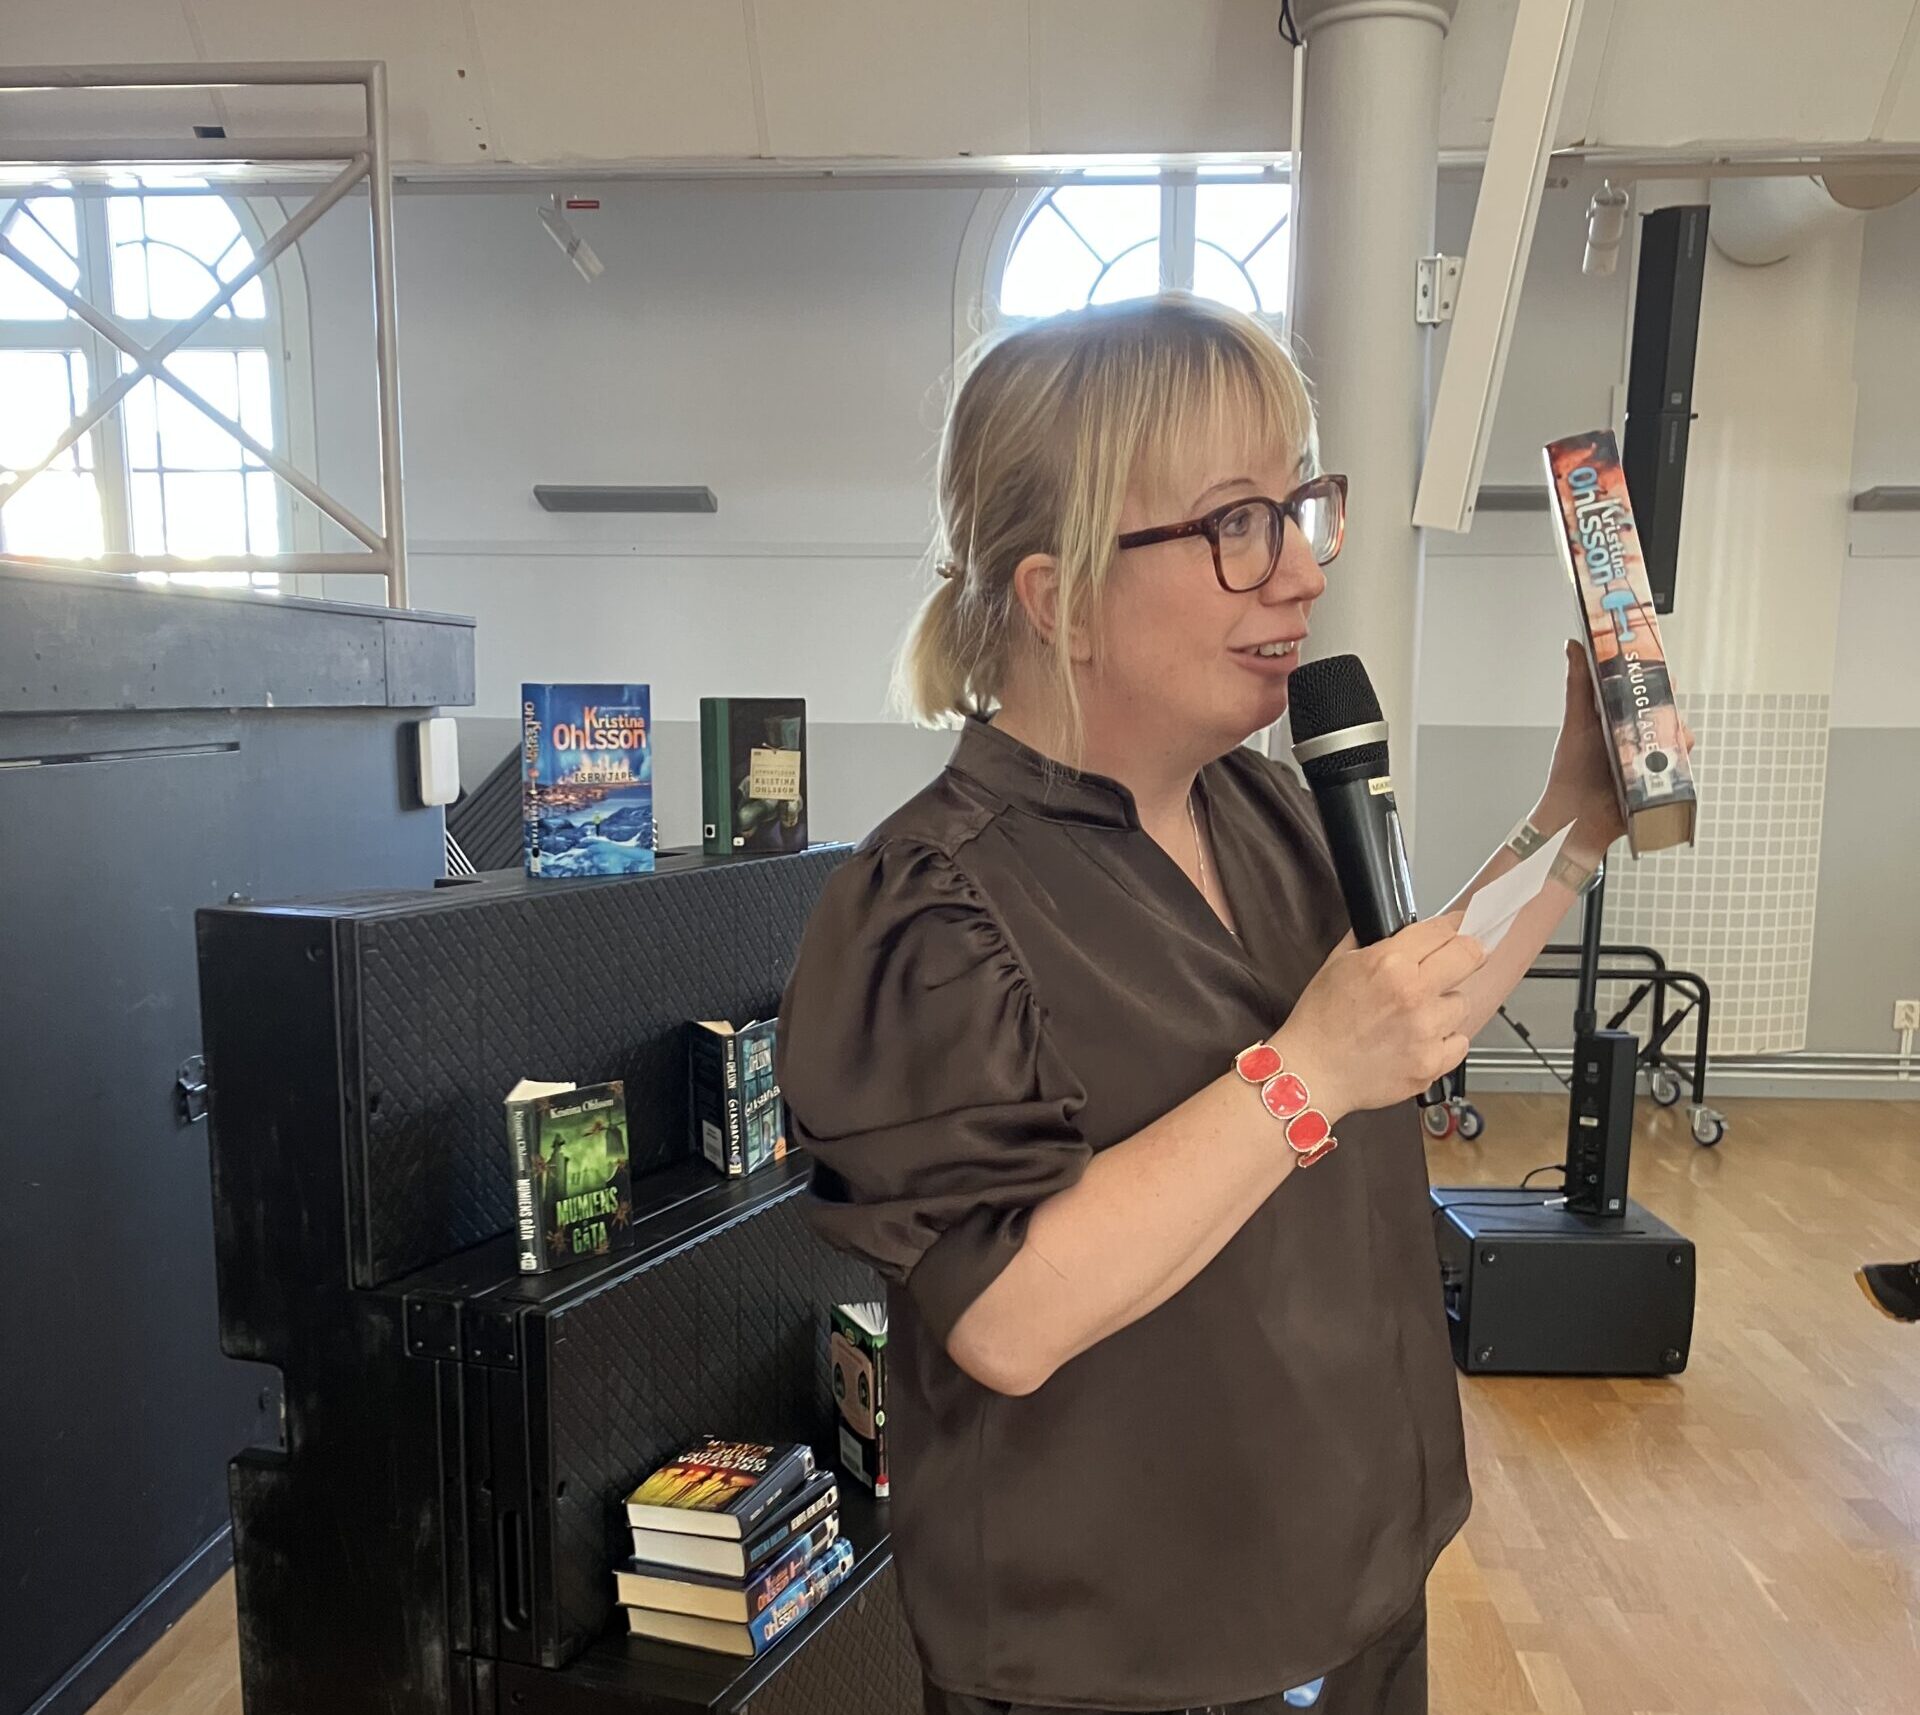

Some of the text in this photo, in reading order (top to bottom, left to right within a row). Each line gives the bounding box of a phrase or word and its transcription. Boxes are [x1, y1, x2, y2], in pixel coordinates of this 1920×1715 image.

[1568, 466, 1613, 586] Ohlsson
[1601, 498, 1626, 577] Kristina
[553, 722, 647, 751] Ohlsson
[584, 706, 645, 729] Kristina
[517, 1179, 533, 1217] MUMIENS
[556, 1186, 619, 1227] MUMIENS
[520, 1218, 536, 1241] GÅTA
